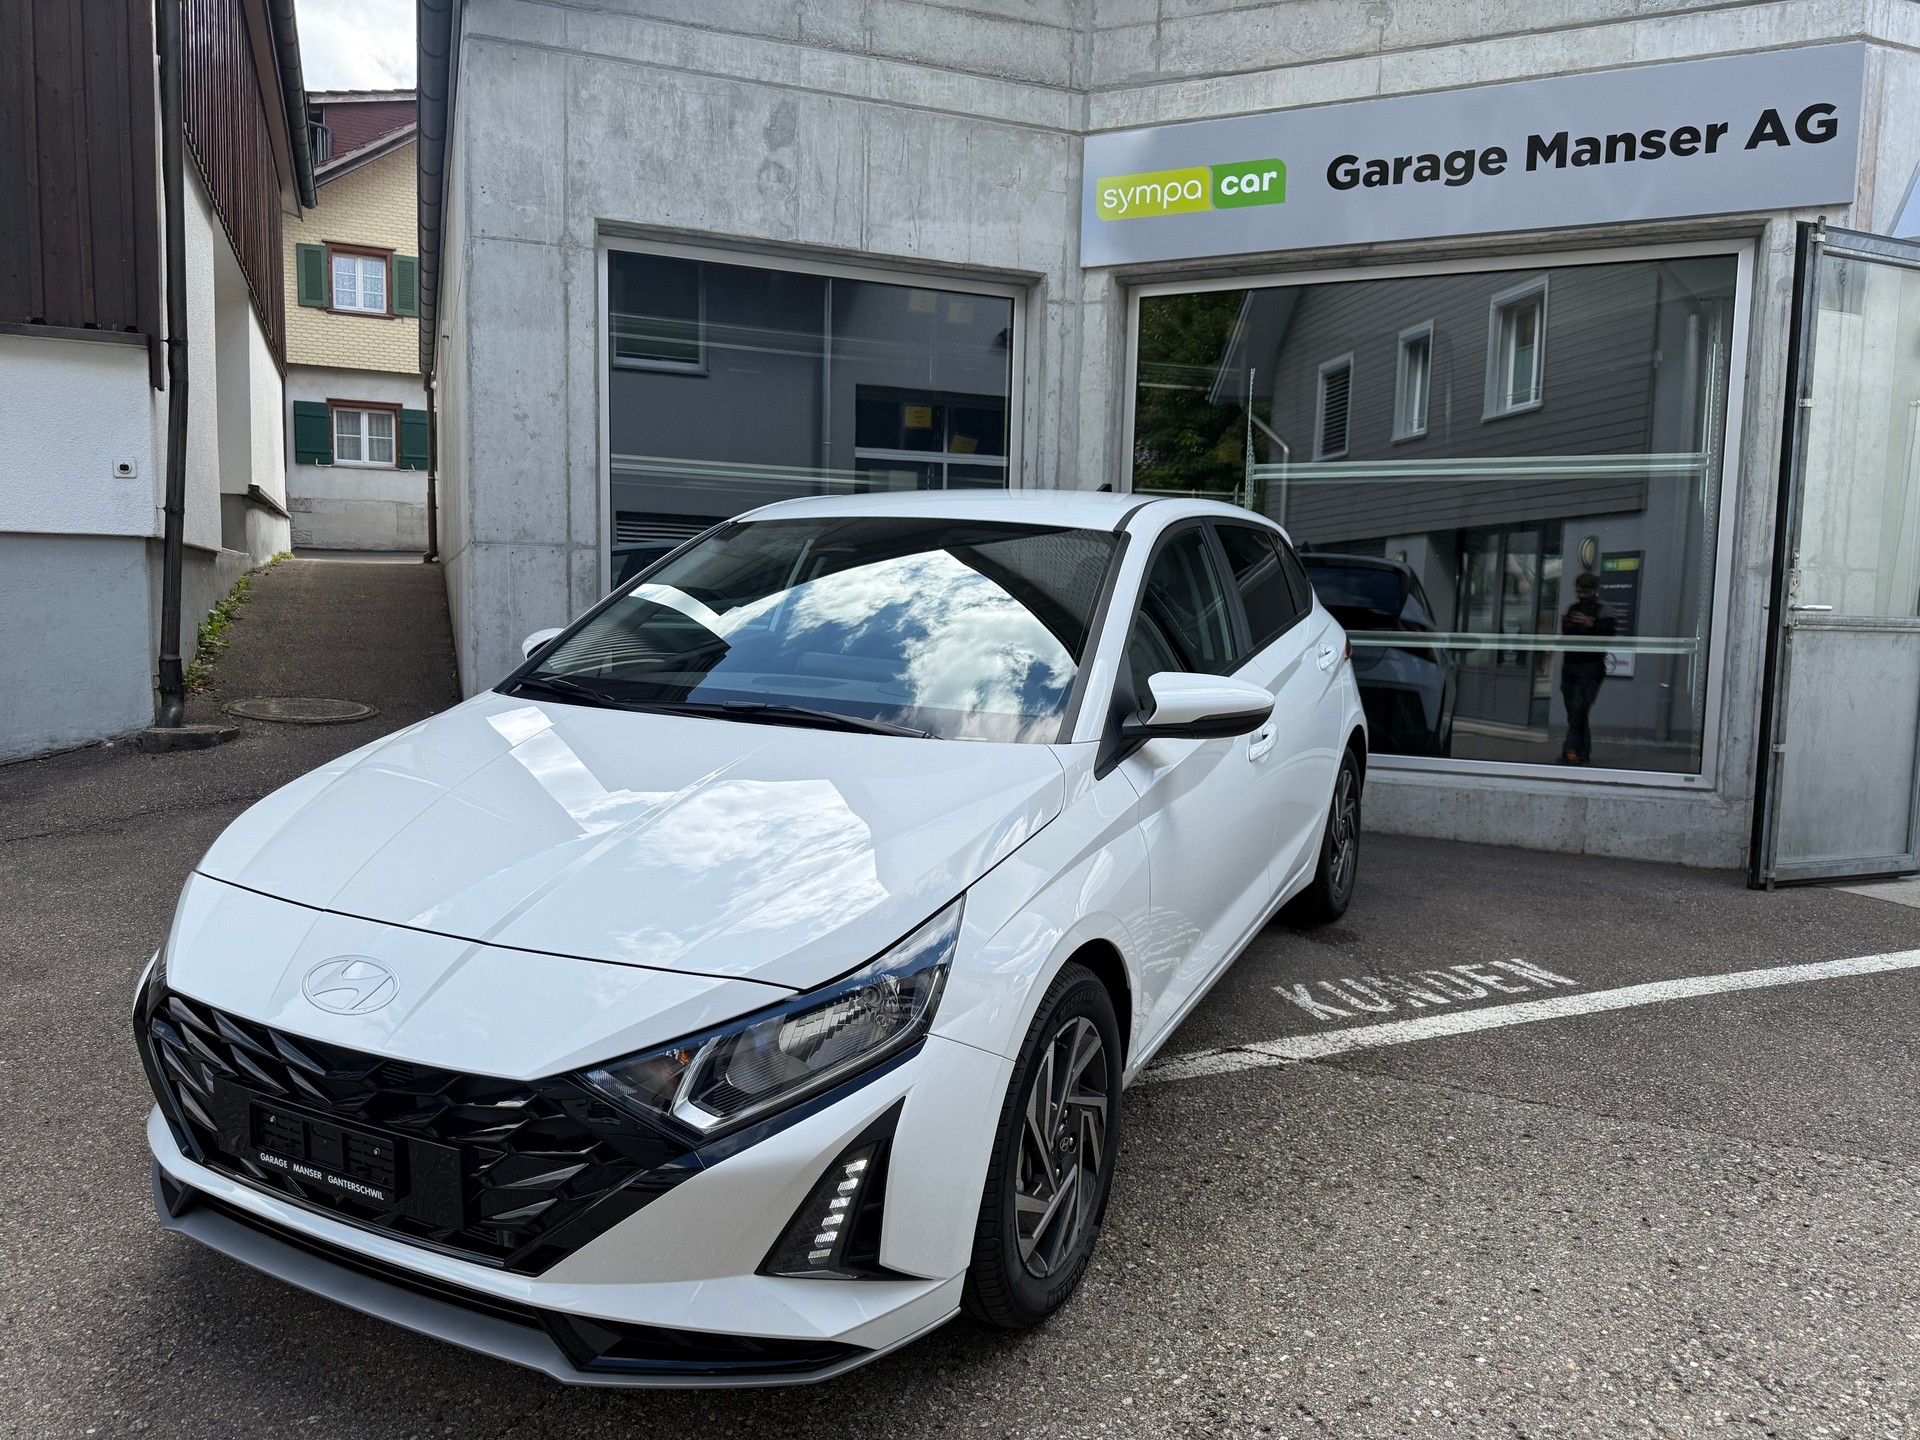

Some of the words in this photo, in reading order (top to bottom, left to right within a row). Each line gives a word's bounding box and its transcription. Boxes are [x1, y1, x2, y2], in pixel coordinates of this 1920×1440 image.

[1327, 146, 1507, 190] Garage
[1526, 122, 1728, 171] Manser
[1746, 103, 1838, 150] AG
[1103, 179, 1202, 213] sympa
[1220, 171, 1277, 195] car
[1271, 958, 1580, 1020] KUNDEN
[260, 1153, 288, 1168] GARAGE
[293, 1163, 322, 1180] MANSER
[328, 1175, 384, 1200] GANTERSCHWIL
